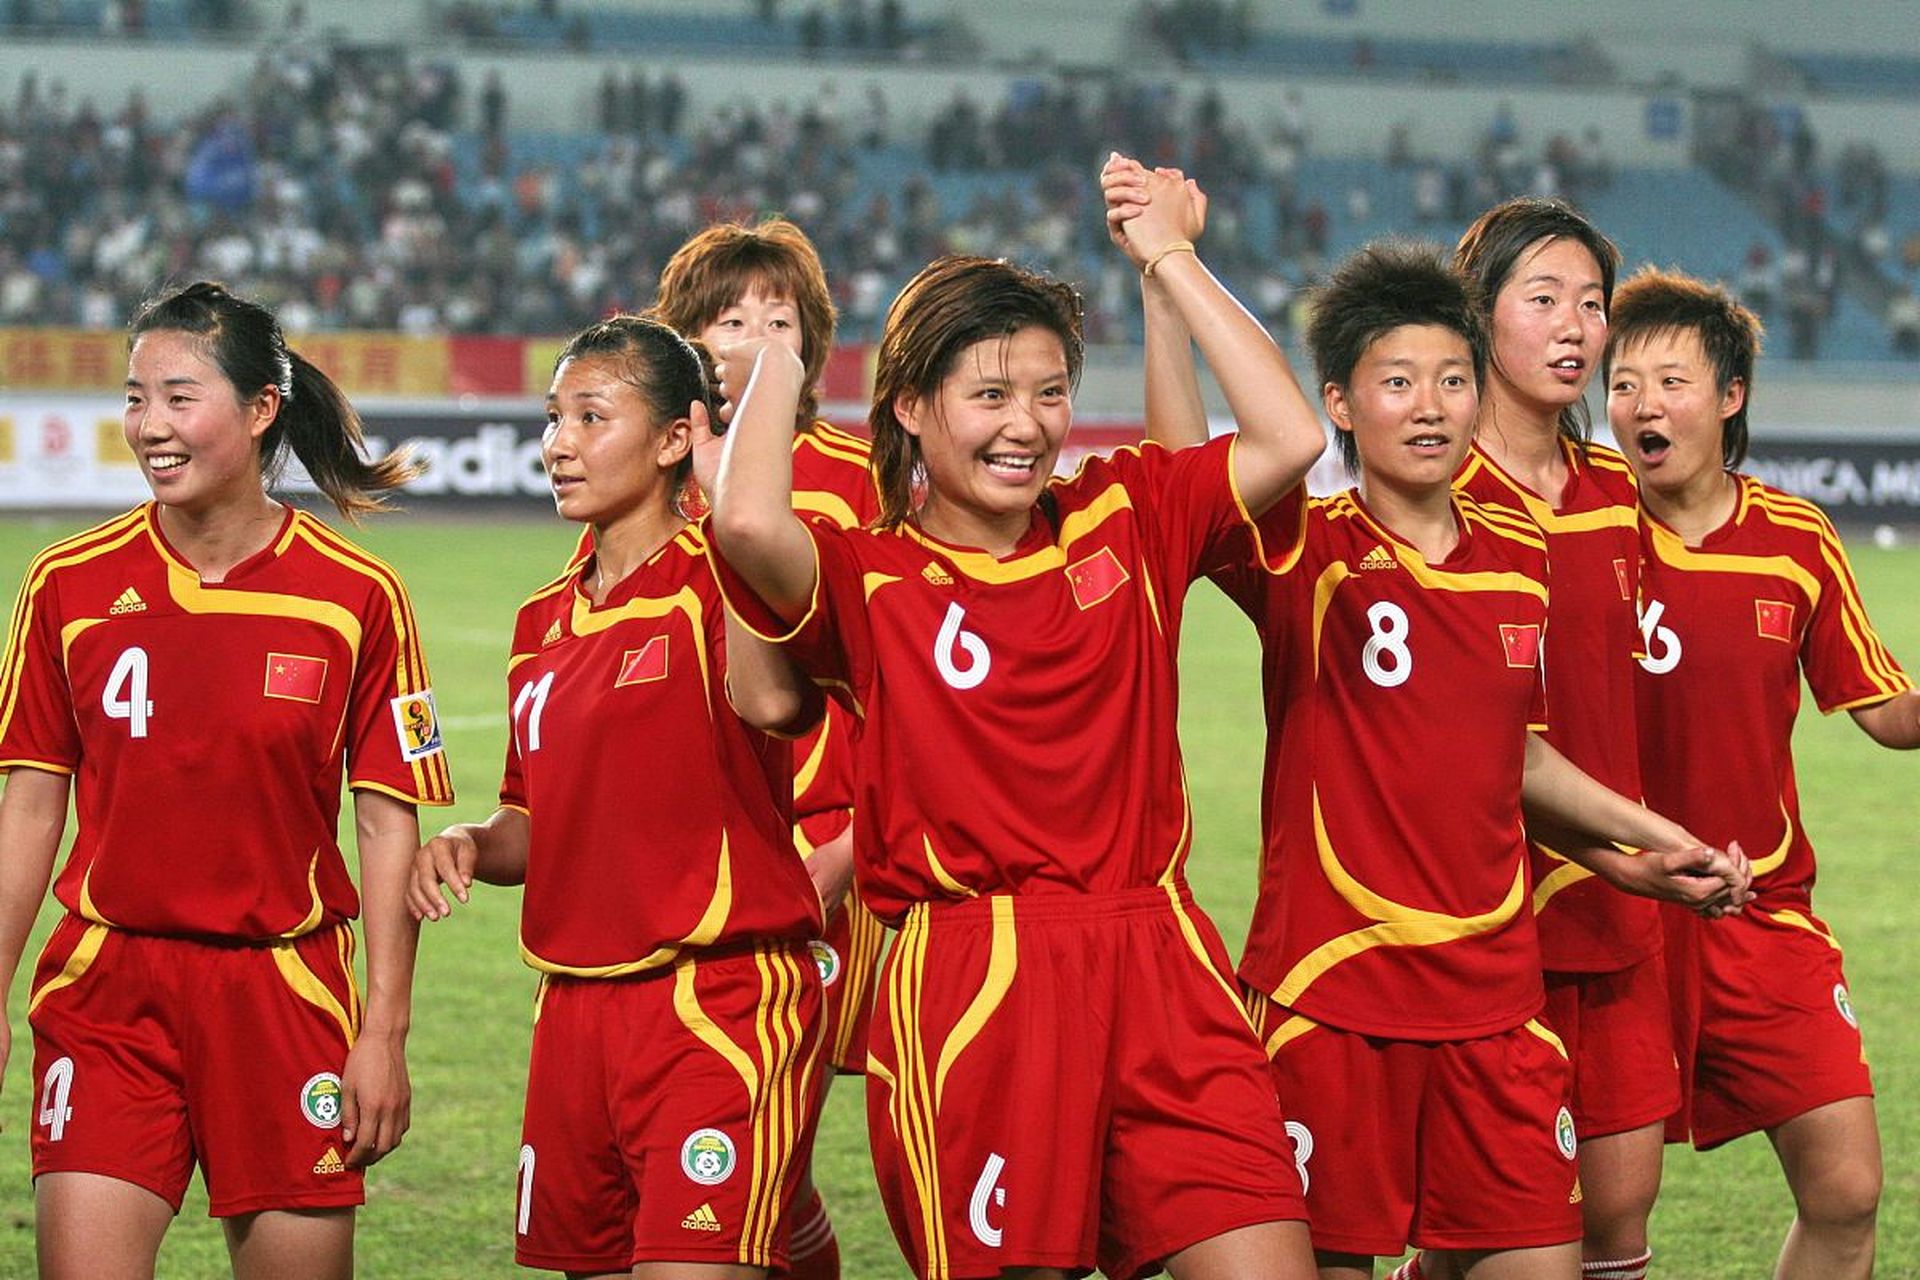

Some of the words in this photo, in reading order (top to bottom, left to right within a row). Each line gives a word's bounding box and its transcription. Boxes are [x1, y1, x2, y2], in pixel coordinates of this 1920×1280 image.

[401, 423, 548, 496] adi
[1737, 457, 1869, 504] NICA
[1360, 559, 1397, 570] adidas
[109, 602, 147, 615] adidas
[933, 601, 991, 690] 6
[1362, 601, 1413, 687] 8
[102, 647, 154, 739] 4
[513, 671, 555, 760] 11
[39, 1056, 75, 1142] 4
[681, 1219, 721, 1232] adidas
